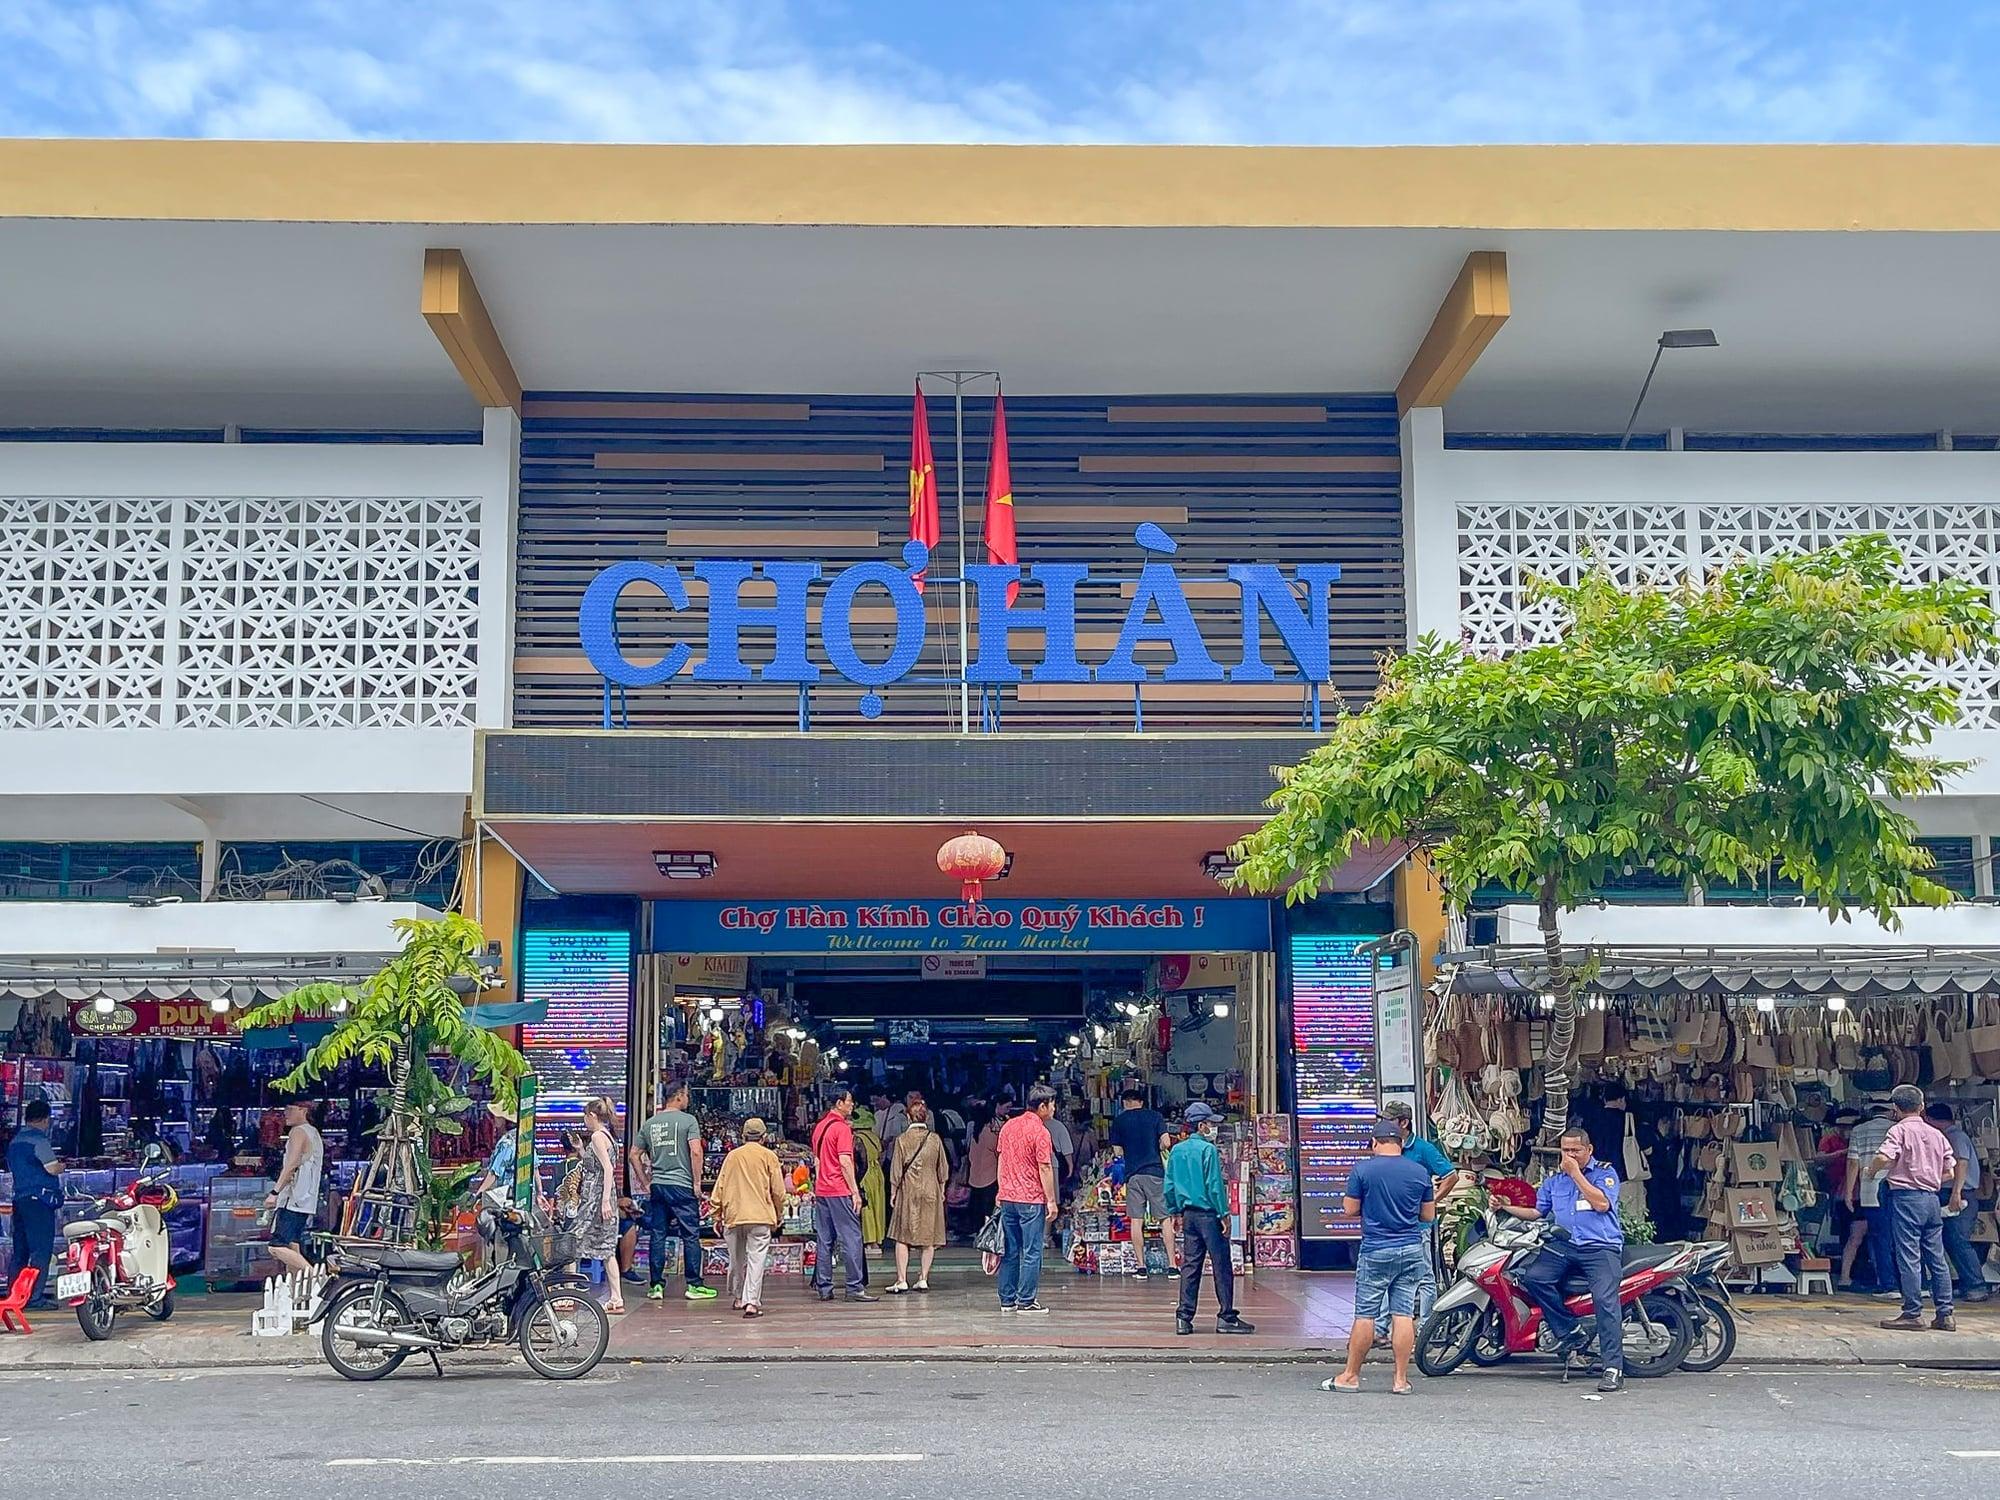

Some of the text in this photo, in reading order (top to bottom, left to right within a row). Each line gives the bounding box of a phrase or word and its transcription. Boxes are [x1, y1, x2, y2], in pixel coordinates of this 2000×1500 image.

[578, 522, 1342, 719] CHỢ HÀN
[719, 905, 1205, 934] Chợ Hàn Kính Chào Quý Khách !
[930, 936, 949, 949] to
[960, 934, 1008, 949] Han
[1018, 935, 1090, 949] Market
[89, 1022, 124, 1031] CHỢ HÀN
